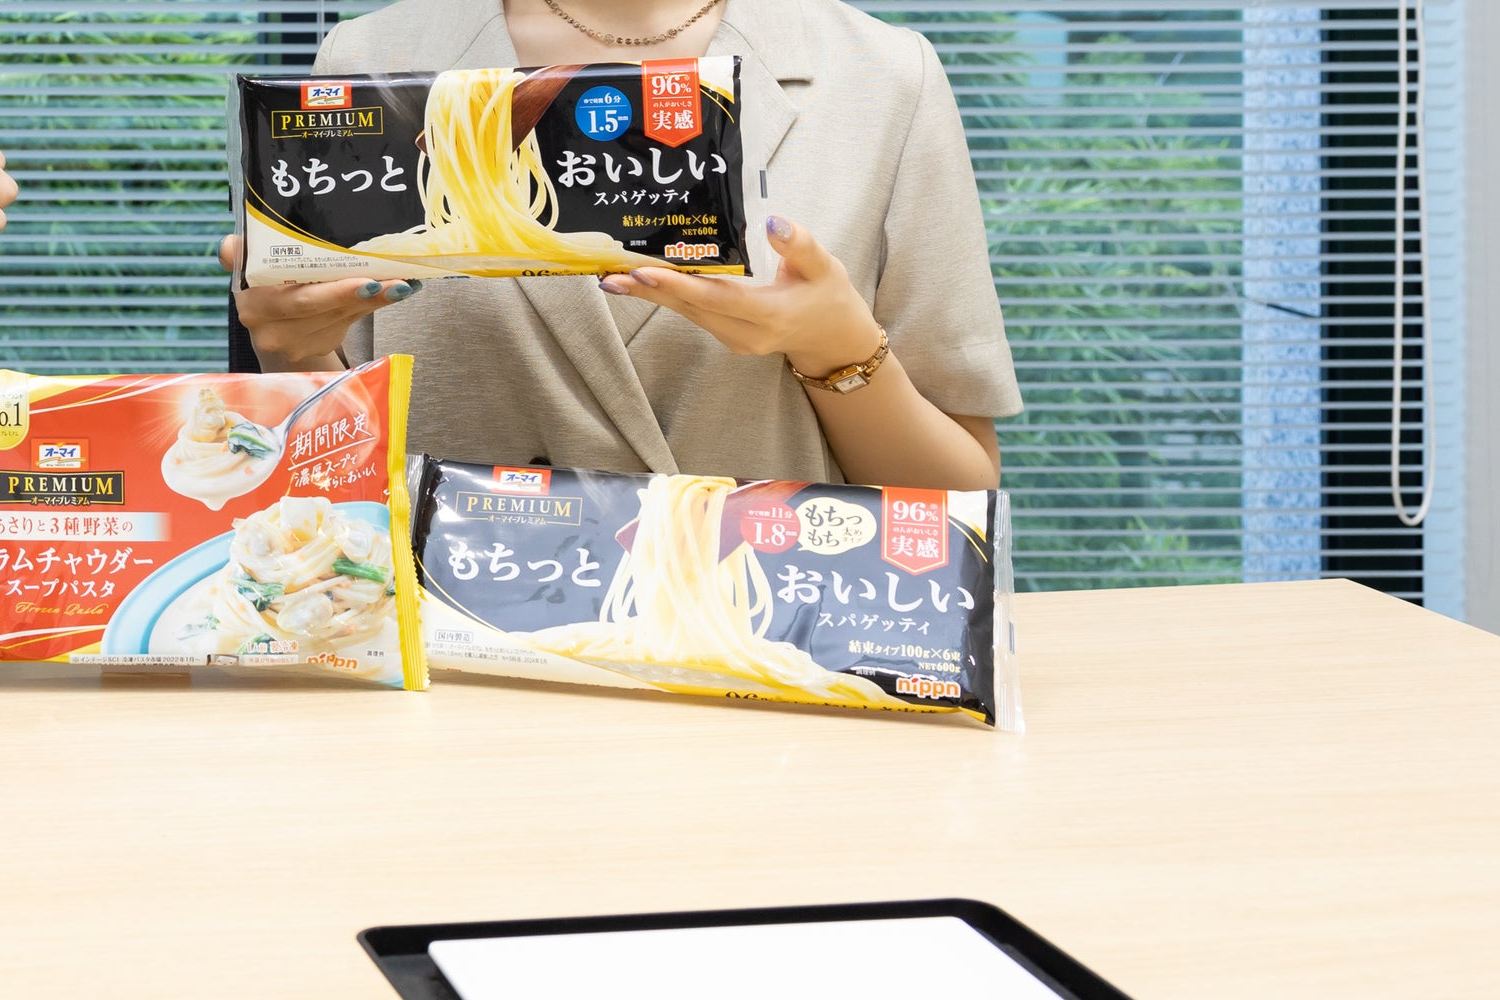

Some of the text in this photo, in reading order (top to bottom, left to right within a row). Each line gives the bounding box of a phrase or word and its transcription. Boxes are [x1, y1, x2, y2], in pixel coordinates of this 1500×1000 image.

[312, 87, 341, 97] オーマイ
[653, 100, 693, 108] の人がおいしさ
[281, 111, 374, 131] PREMIUM
[652, 110, 694, 130] 実感
[271, 155, 408, 197] もちっと
[556, 147, 728, 188] おいしい
[593, 188, 690, 206] スパゲッティ
[665, 242, 719, 260] nippn
[289, 411, 373, 460] 期間限定
[44, 447, 77, 458] オーマイ
[8, 476, 114, 495] PREMIUM
[506, 473, 538, 482] オーマイ
[466, 496, 572, 517] PREMIUM
[805, 504, 863, 527] もちっ
[807, 529, 841, 547] もち
[892, 527, 939, 536] の人がおいしさ
[891, 535, 940, 559] 実感
[448, 542, 601, 587] もちっと
[5, 578, 116, 598] スープパスタ
[776, 564, 975, 613] おいしい
[15, 601, 109, 616] Frozen Pasta
[816, 612, 931, 636] スパゲッティ
[896, 677, 961, 700] nippn
